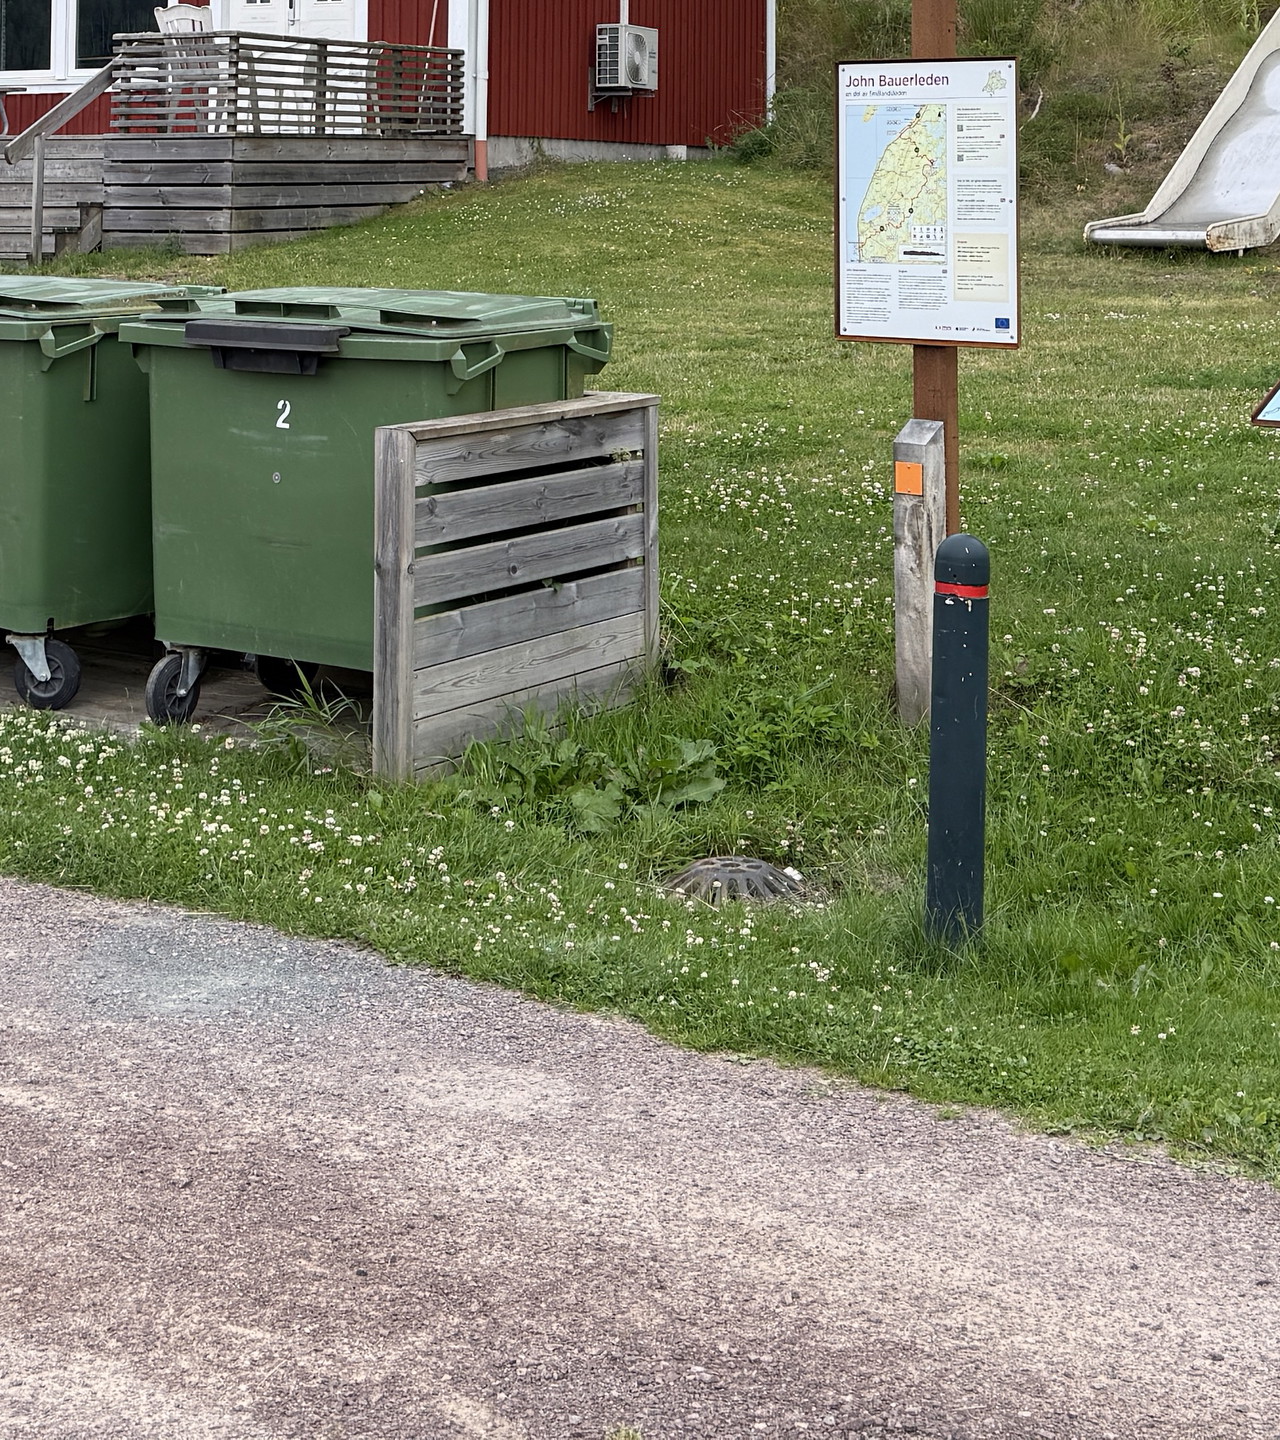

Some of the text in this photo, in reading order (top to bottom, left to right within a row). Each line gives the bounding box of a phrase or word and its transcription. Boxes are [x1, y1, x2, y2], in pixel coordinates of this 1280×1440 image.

[846, 73, 949, 88] John Bauerleden
[276, 399, 291, 429] 2
